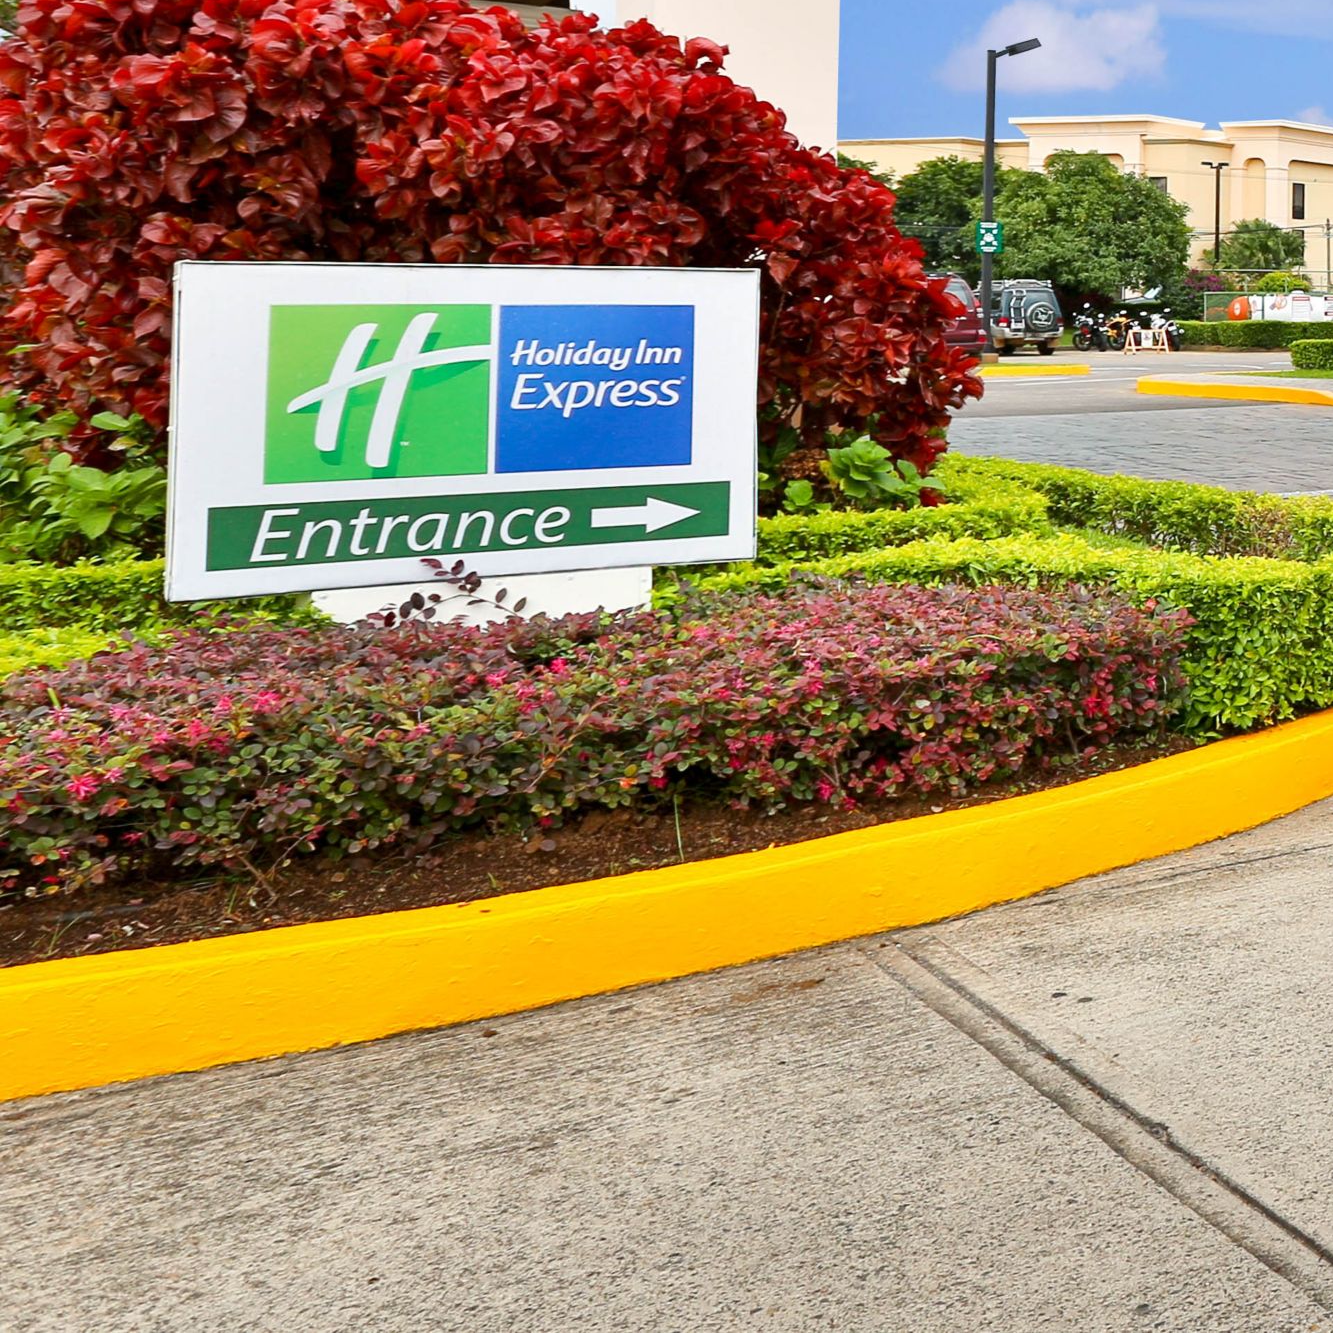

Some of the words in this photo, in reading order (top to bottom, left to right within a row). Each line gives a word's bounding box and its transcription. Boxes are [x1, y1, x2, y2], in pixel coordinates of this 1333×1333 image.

[509, 338, 632, 372] Holiday
[634, 338, 683, 365] Inn
[509, 372, 683, 419] Express
[248, 504, 571, 564] Entrance
